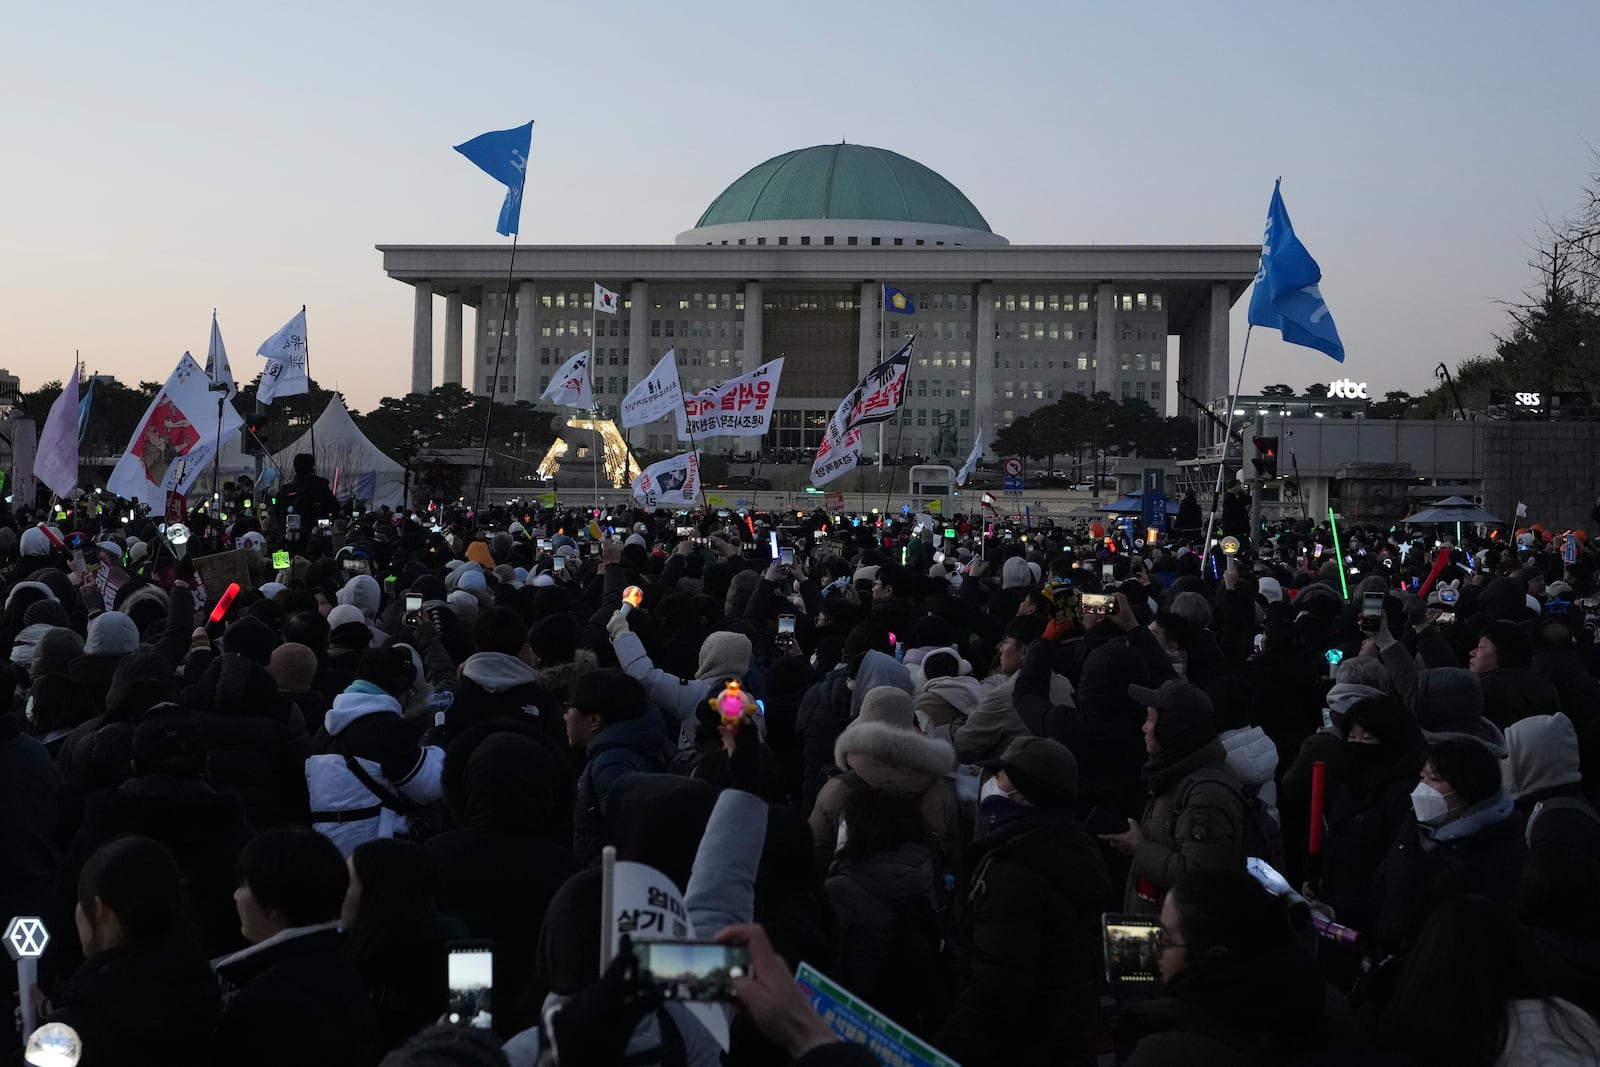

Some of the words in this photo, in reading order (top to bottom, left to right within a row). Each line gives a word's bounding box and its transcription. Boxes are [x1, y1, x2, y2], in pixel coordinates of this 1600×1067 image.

[1327, 378, 1367, 399] jtbc
[1515, 392, 1541, 406] SBS
[1150, 472, 1157, 490] 1
